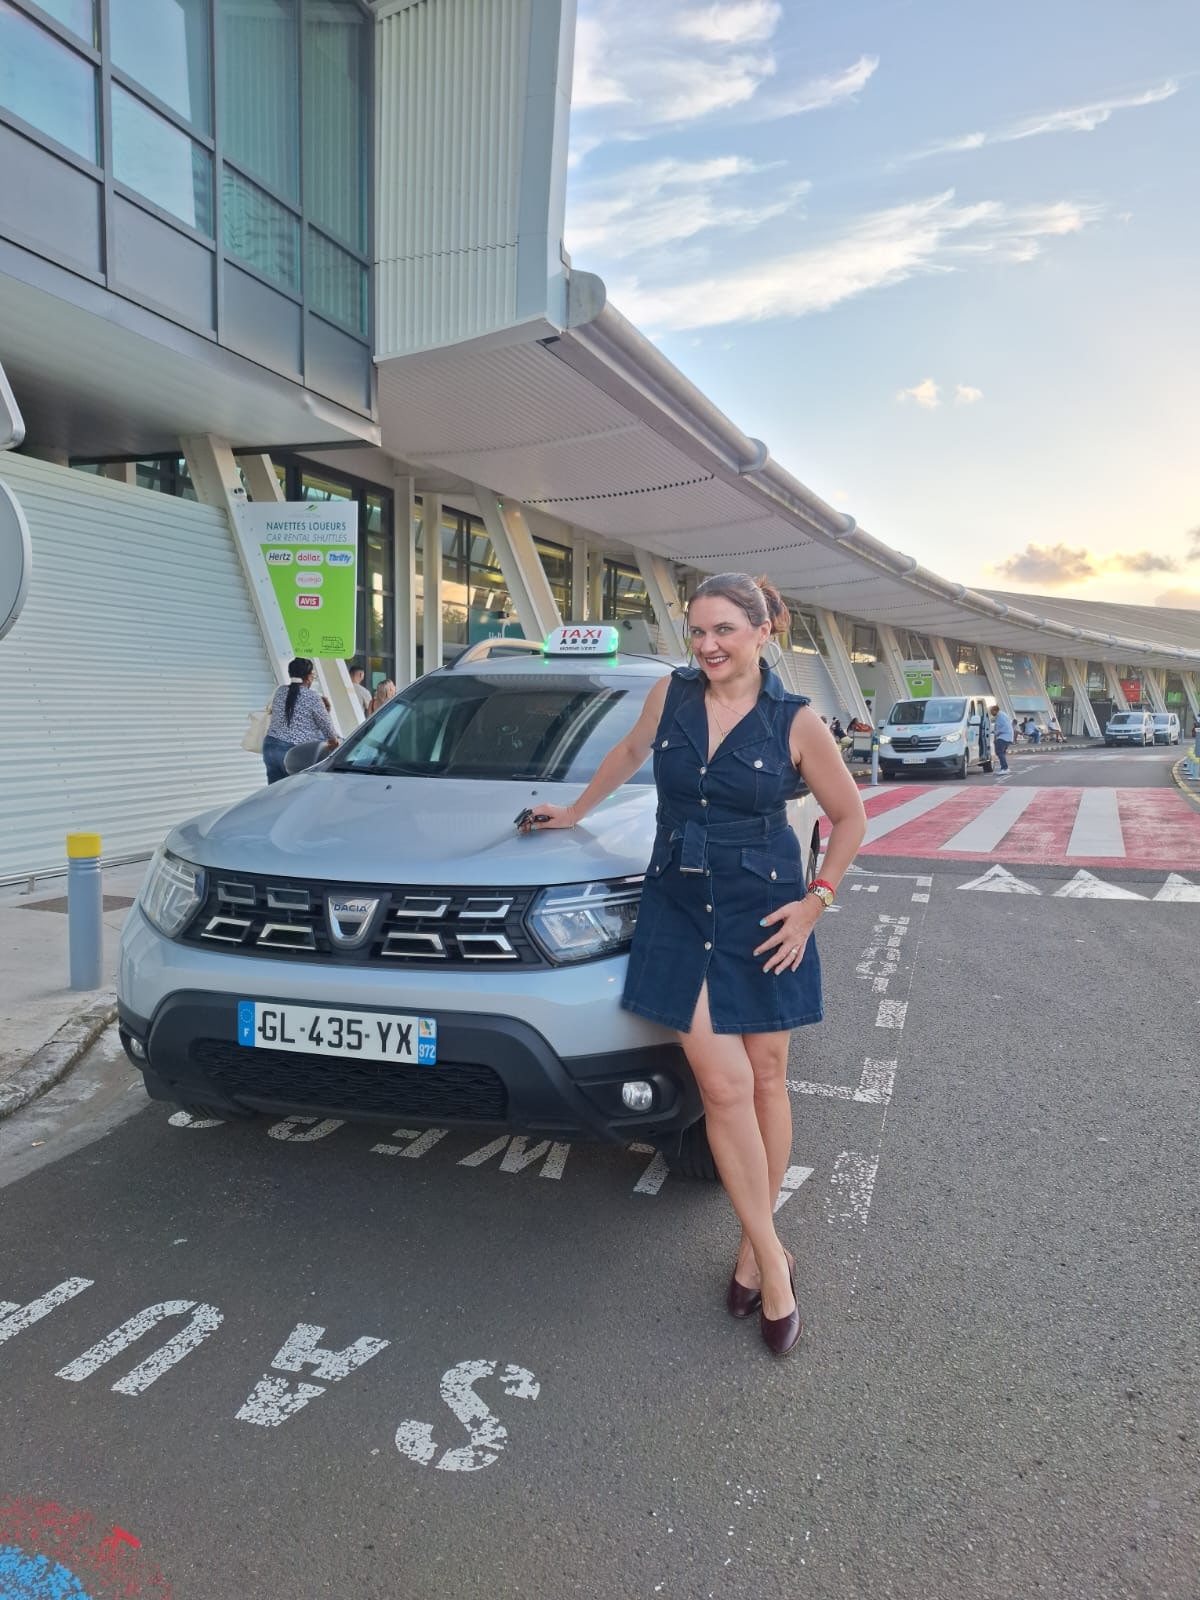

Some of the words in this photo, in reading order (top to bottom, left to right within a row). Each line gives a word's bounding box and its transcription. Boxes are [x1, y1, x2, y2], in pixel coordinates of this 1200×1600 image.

[266, 521, 306, 531] NAVETTES
[309, 521, 347, 531] LOUEURS
[266, 533, 282, 542] CAR
[284, 533, 310, 542] RENTAL
[312, 533, 348, 543] SHUTTLES
[268, 552, 292, 561] Hertz
[300, 597, 317, 607] AVIS
[560, 629, 603, 638] TAXI
[333, 904, 368, 913] DACIA
[243, 1028, 250, 1038] F
[418, 1043, 436, 1059] 972
